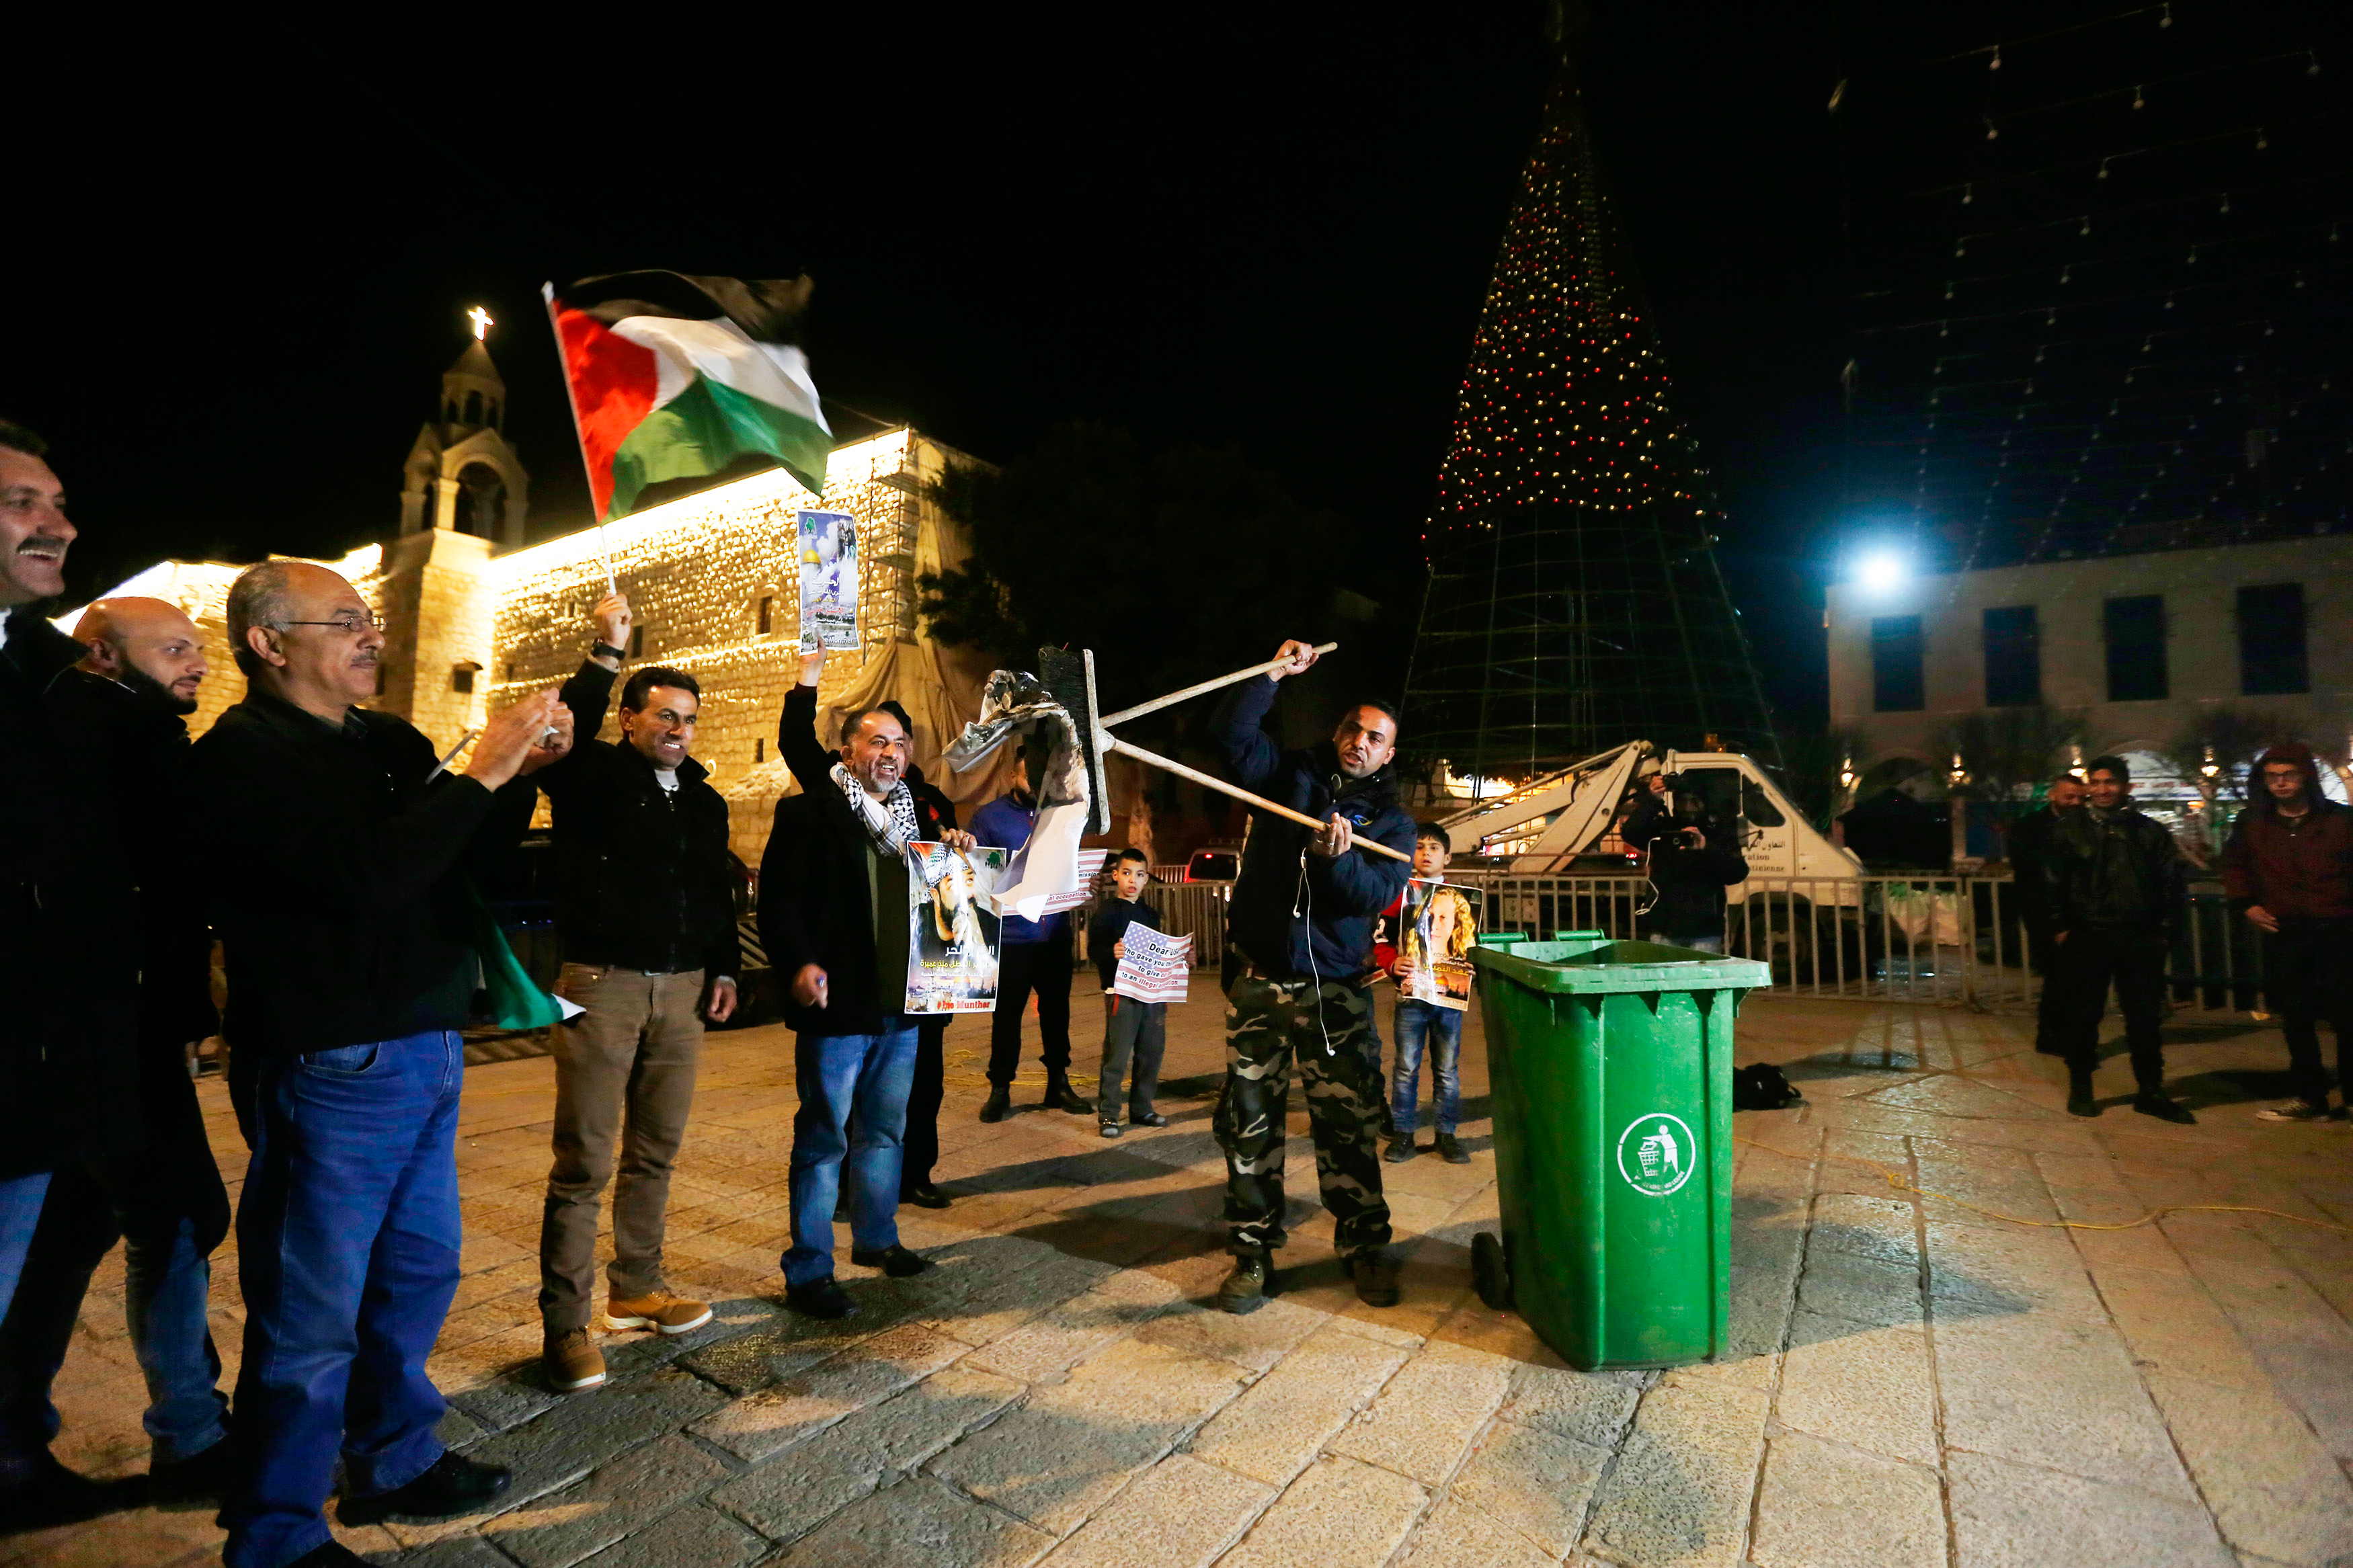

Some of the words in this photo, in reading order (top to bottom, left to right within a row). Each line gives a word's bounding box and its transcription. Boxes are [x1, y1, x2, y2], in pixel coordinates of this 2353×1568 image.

[1055, 891, 1086, 900] occupation
[1149, 943, 1169, 956] Dear
[1136, 953, 1152, 963] gave
[920, 959, 936, 968] عميرة
[1138, 978, 1158, 989] illegal
[957, 1000, 990, 1009] Munther
